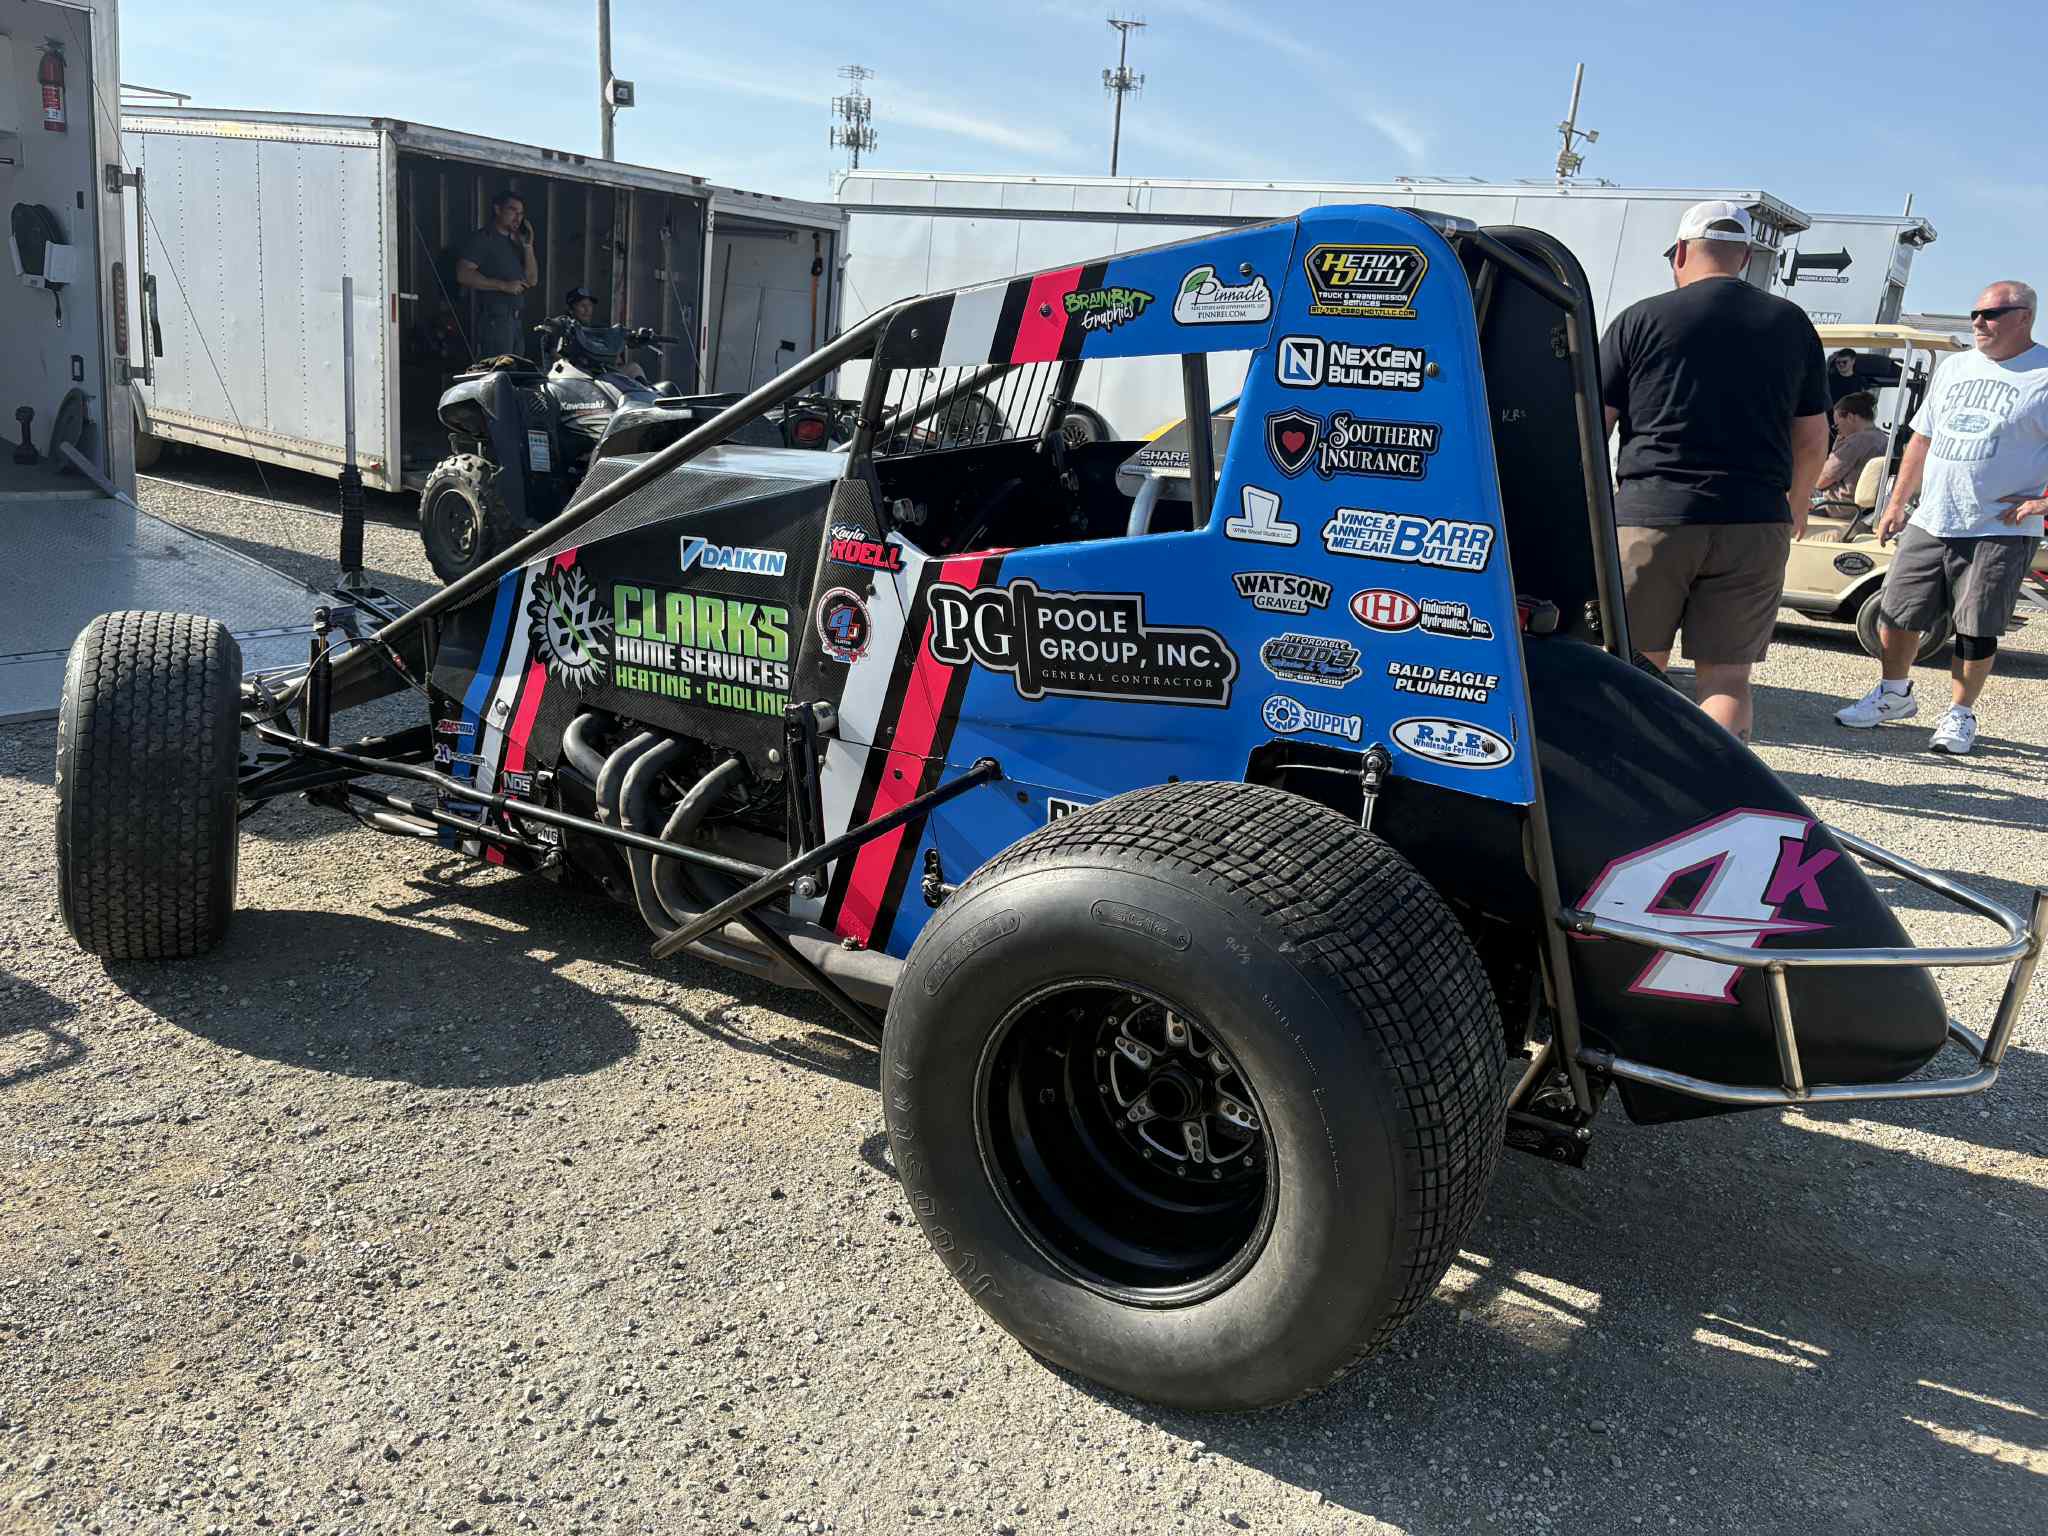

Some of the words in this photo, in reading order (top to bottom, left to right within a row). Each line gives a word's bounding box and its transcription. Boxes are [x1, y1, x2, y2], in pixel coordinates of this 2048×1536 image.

[1322, 254, 1409, 271] HEAVY
[1330, 268, 1405, 286] DUTY
[1196, 280, 1267, 306] Pinnacle
[1082, 298, 1134, 329] Graphics
[1329, 344, 1422, 369] NEXGEN
[1328, 367, 1421, 388] BUILDERS
[1942, 378, 2020, 419] SPORTS
[1330, 416, 1434, 449] SOUTHERN
[1140, 451, 1190, 461] SHARP
[1319, 442, 1420, 473] INSURANCE
[831, 526, 865, 541] Kayla
[1328, 525, 1394, 542] ANNETTE
[1341, 513, 1383, 528] VINCE
[1385, 519, 1395, 530] &
[1331, 537, 1391, 554] MELEAH
[1392, 520, 1490, 557] BARR
[703, 546, 785, 573] DAIKIN
[831, 540, 901, 569] ROELL
[1237, 575, 1328, 606] WATSON
[1256, 595, 1305, 610] GRAVEL
[1361, 594, 1410, 622] IHI
[1423, 601, 1465, 617] Industrial
[937, 598, 1016, 656] PG
[1038, 608, 1127, 634] POOLE
[1421, 615, 1470, 632] Hydraulics,
[1473, 620, 1489, 634] Inc.
[1039, 638, 1147, 669] GROUP,
[1158, 643, 1221, 668] INC.
[1268, 642, 1355, 666] TODD'S
[1283, 635, 1347, 649] AFFORDABLE
[615, 635, 676, 670] HOME
[680, 647, 789, 690] SERVICES
[1388, 662, 1435, 679] BALD
[1439, 669, 1498, 688] EAGLE
[616, 664, 691, 699] HEATING
[706, 682, 790, 717] COOLING
[1042, 669, 1104, 682] GENERAL
[1111, 674, 1214, 688] CONTRACTOR
[1395, 678, 1488, 702] PLUMBING
[1303, 711, 1357, 736] SUPPLY
[1413, 737, 1452, 752] Wholesale
[1453, 745, 1489, 759] Fertilizer
[1567, 807, 1841, 1006] 4K
